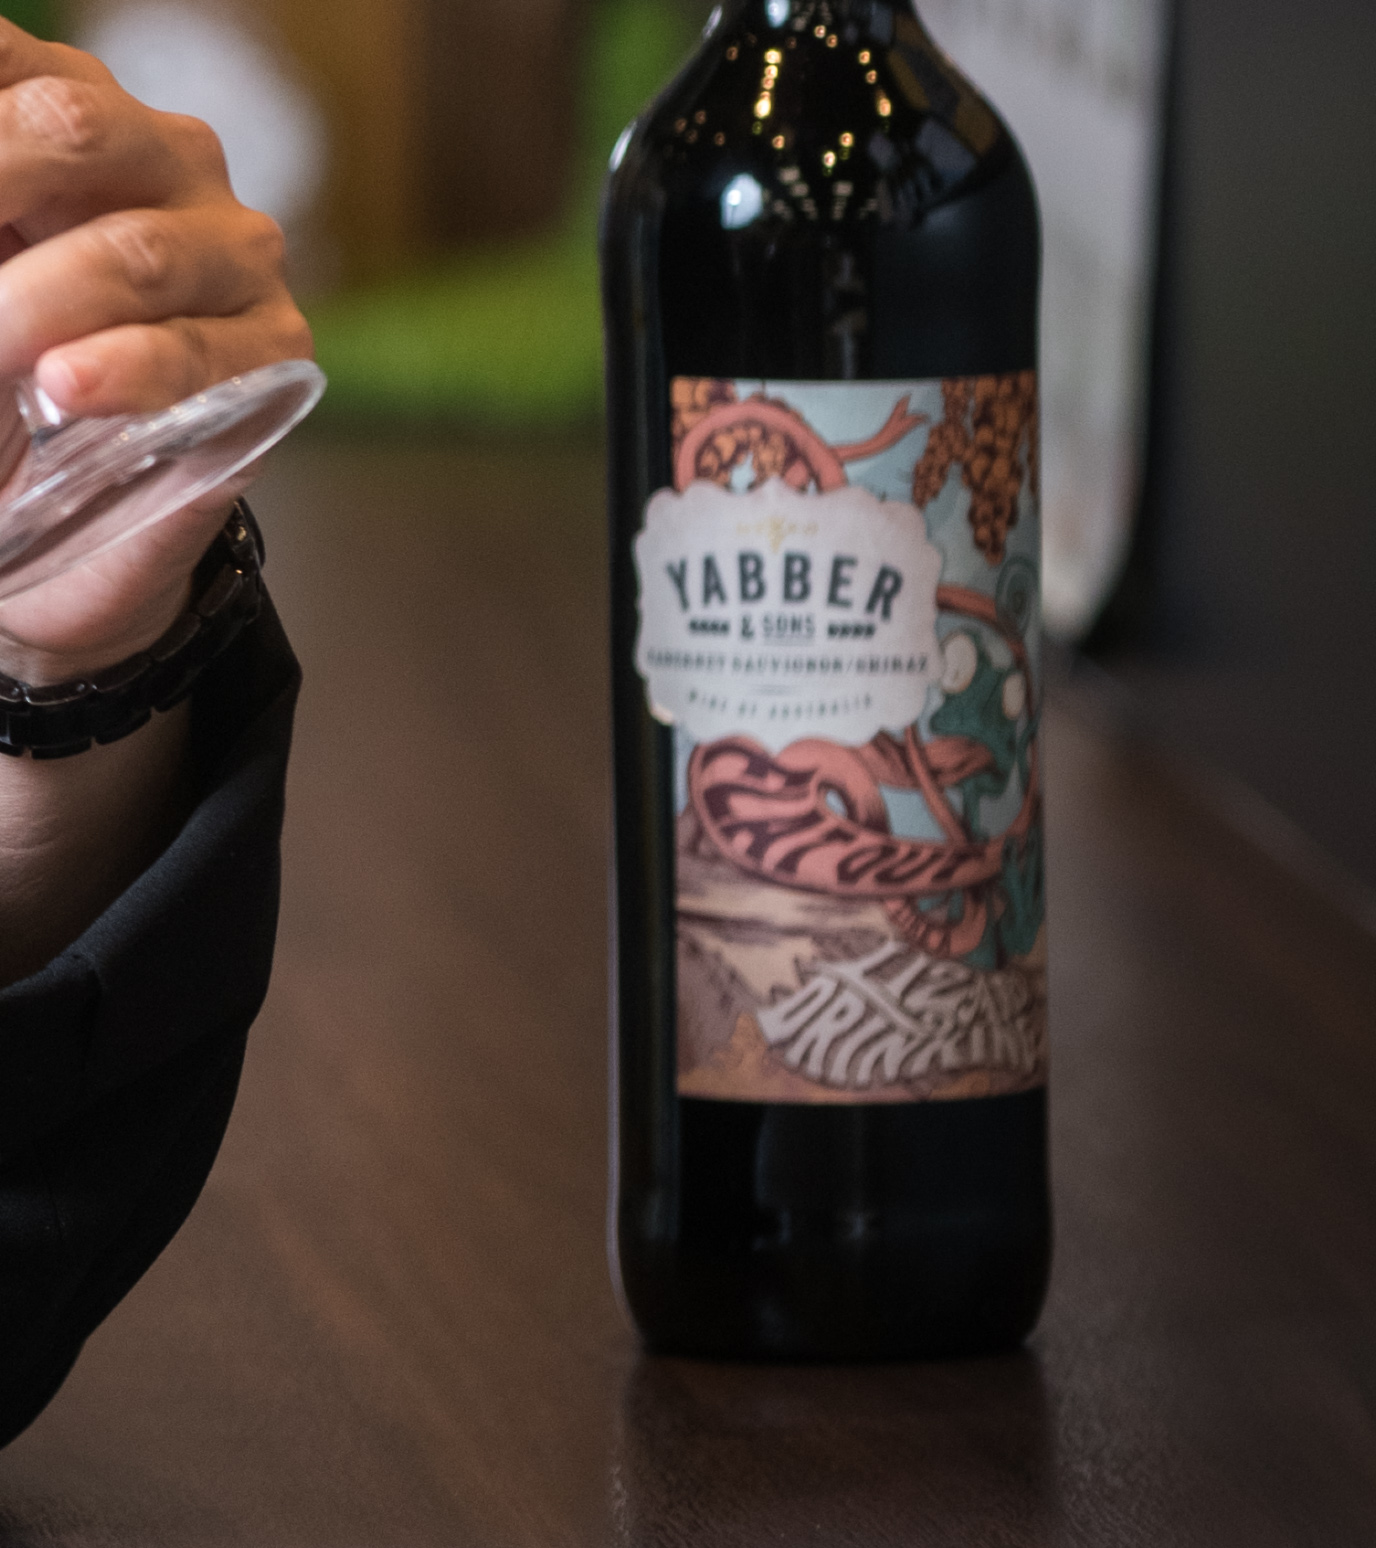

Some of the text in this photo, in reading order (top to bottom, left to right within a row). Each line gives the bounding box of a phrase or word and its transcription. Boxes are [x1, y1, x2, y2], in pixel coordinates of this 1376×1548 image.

[666, 551, 904, 622] YABBER
[740, 613, 816, 640] & SONS
